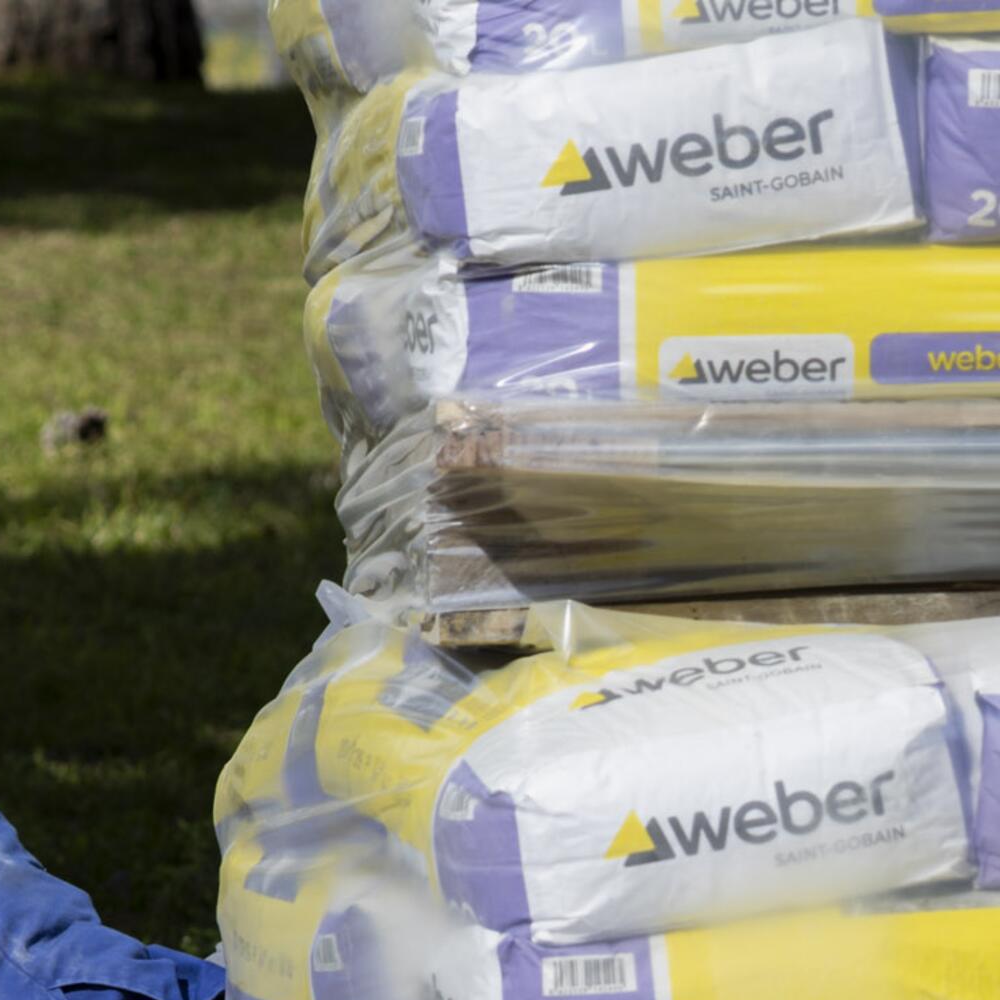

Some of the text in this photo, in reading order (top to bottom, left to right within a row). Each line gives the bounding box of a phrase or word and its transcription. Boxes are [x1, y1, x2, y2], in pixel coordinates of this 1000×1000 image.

[605, 109, 834, 188] weber
[709, 165, 845, 202] SAINT-GOBAIN
[967, 189, 1000, 228] 2
[706, 350, 847, 384] weber
[621, 646, 810, 695] weber
[667, 769, 895, 857] weber
[774, 824, 906, 867] SAINT-GOBAIN
